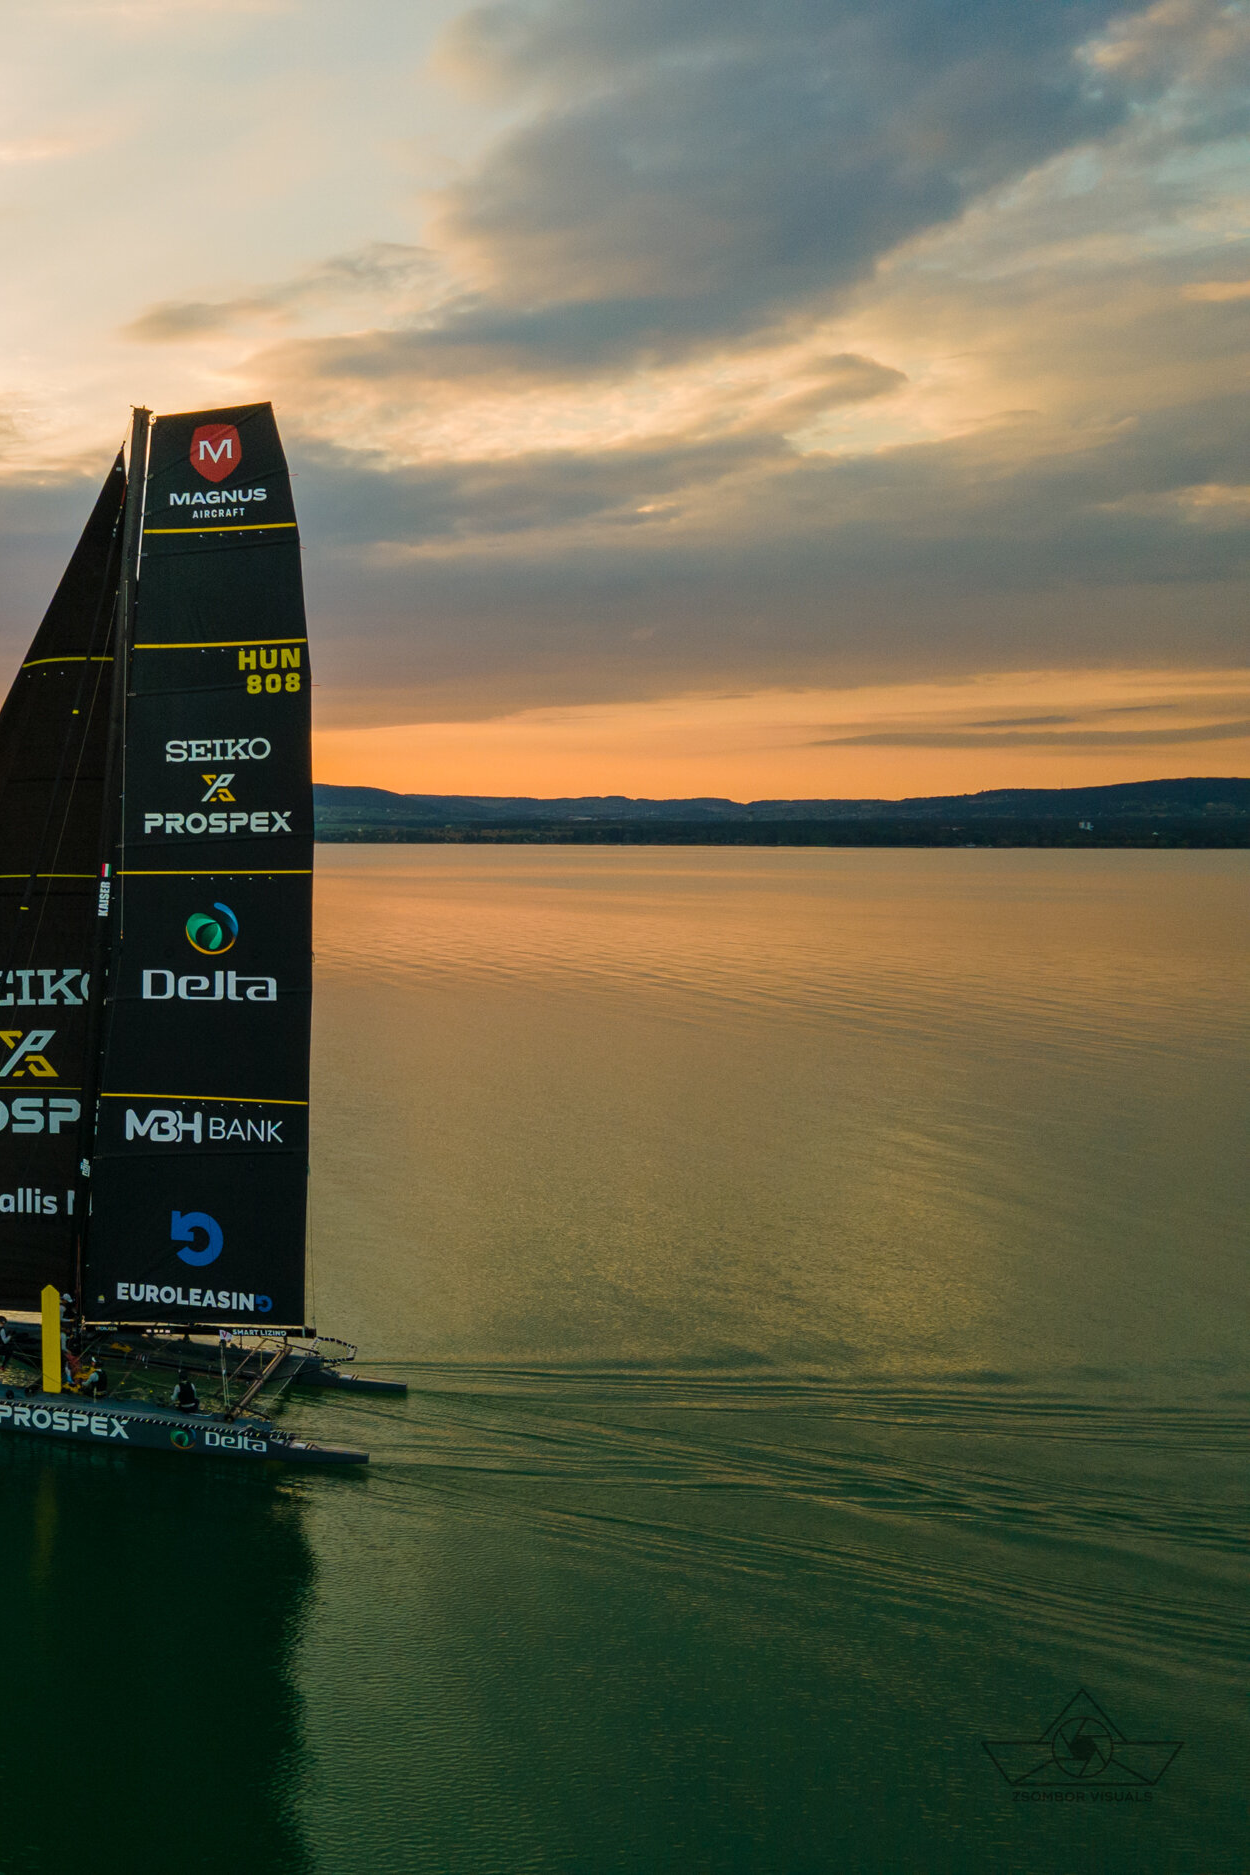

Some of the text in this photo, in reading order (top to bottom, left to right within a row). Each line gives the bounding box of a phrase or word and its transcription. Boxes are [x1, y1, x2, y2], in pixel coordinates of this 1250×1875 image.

[199, 439, 232, 463] M
[169, 488, 267, 506] MAGNUS
[192, 507, 245, 519] AIRCRAFT
[238, 648, 300, 670] HUN
[246, 673, 301, 694] 808
[165, 737, 271, 762] SEIKO
[144, 811, 292, 834] PROSPEX
[98, 881, 111, 916] KAISER
[142, 969, 277, 1001] Delta
[125, 1108, 283, 1144] MBH BANK
[232, 1328, 259, 1336] SMART
[205, 1431, 267, 1453] Delta
